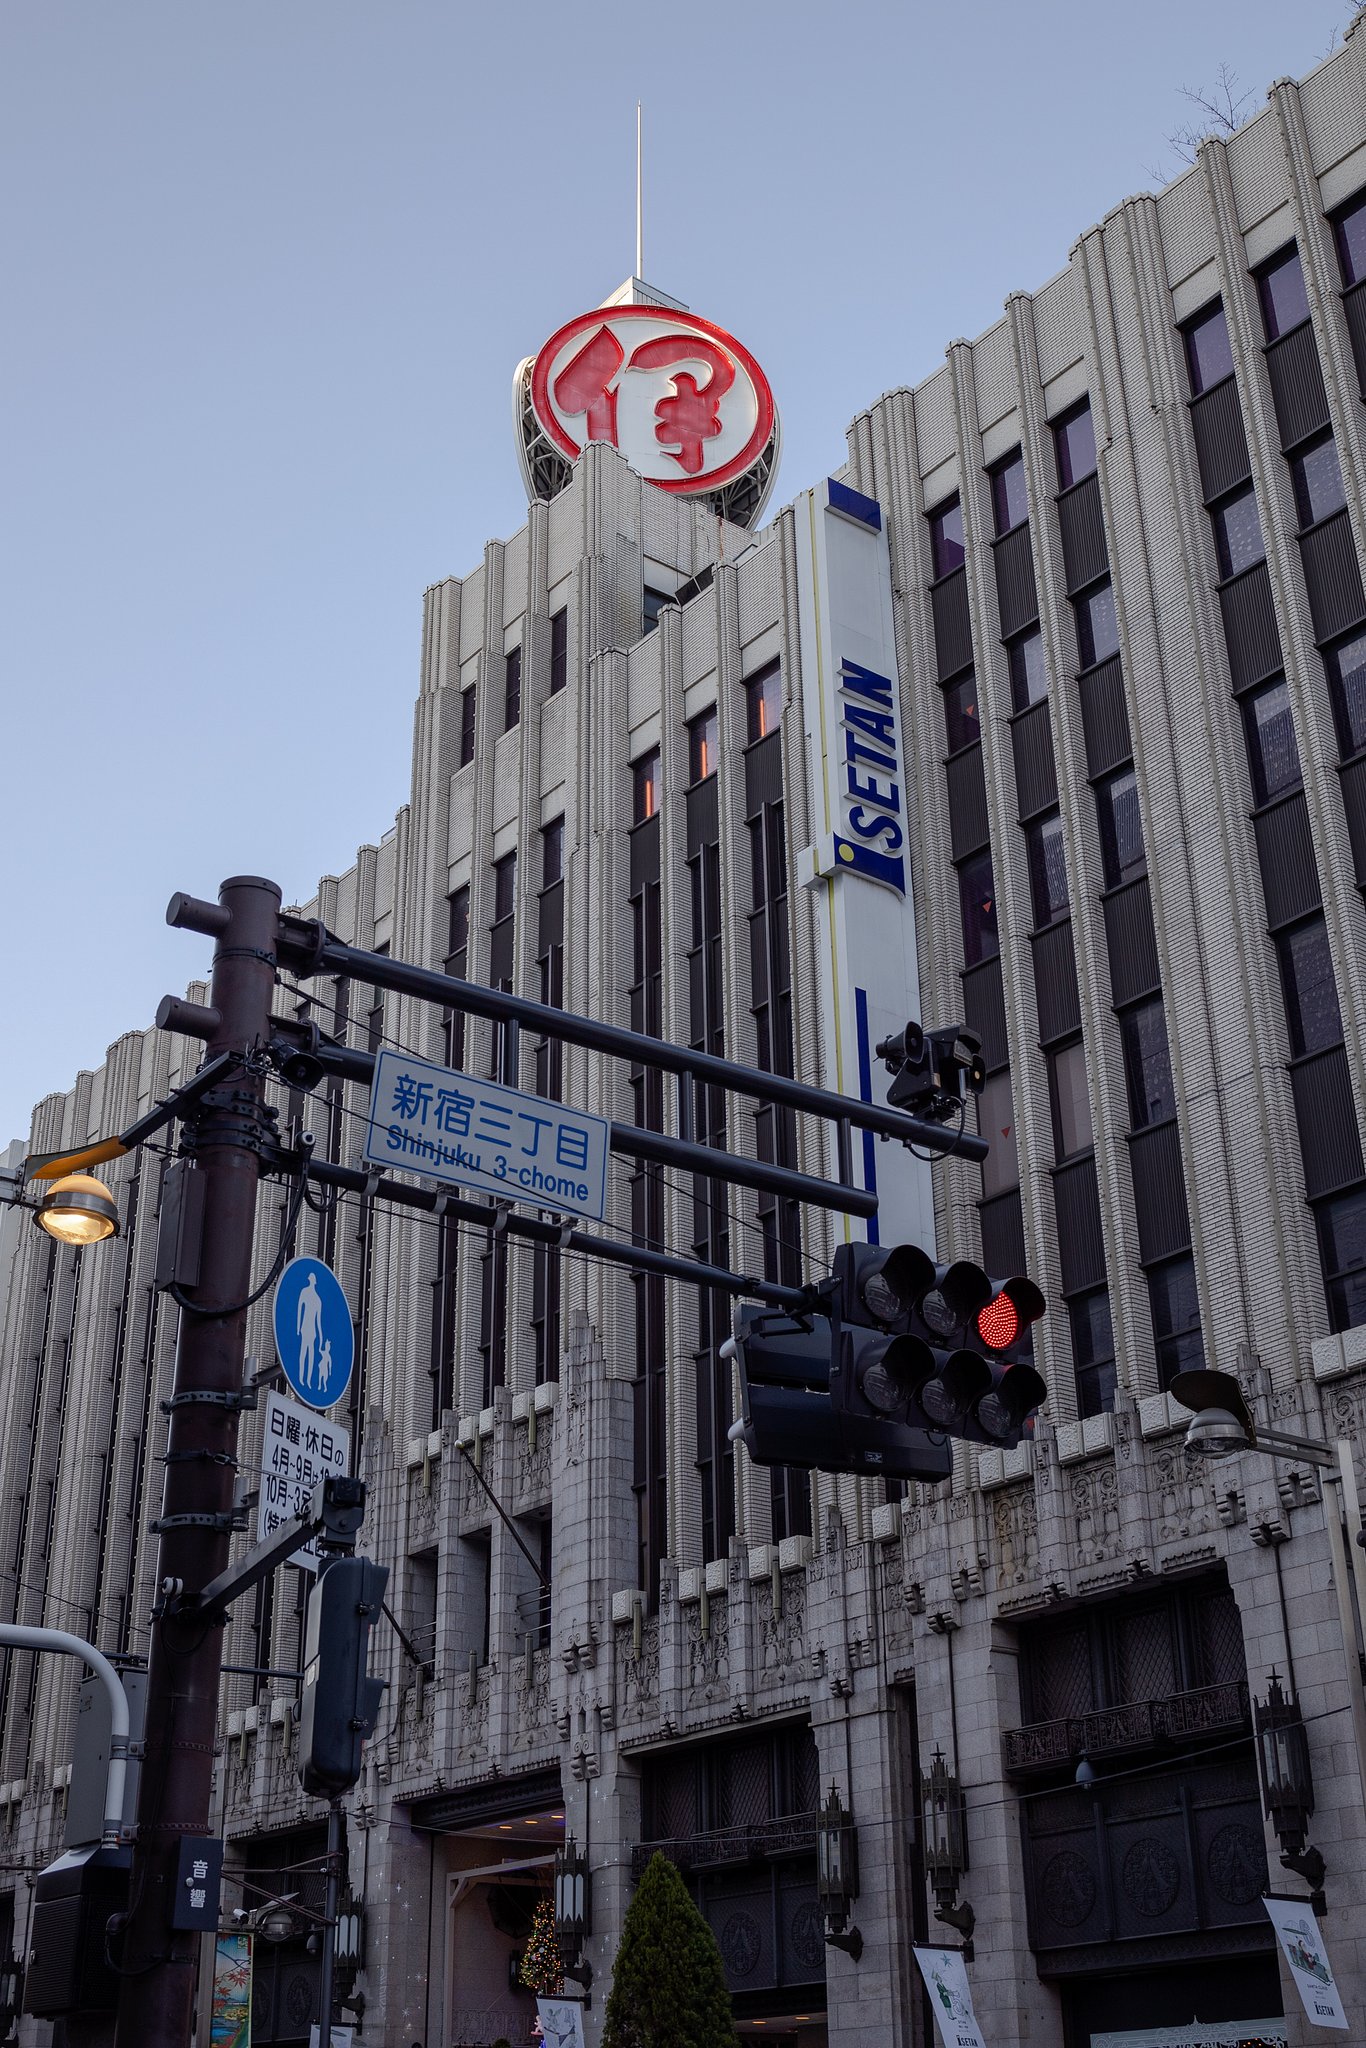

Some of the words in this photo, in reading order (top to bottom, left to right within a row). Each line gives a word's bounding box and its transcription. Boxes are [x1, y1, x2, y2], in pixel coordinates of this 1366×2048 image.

[391, 1073, 588, 1171] 新宿三丁目
[386, 1124, 481, 1172] Shinjuku
[493, 1155, 589, 1201] 3-chome
[271, 1407, 344, 1467] 日曜・休日の
[190, 1859, 208, 1908] 音響
